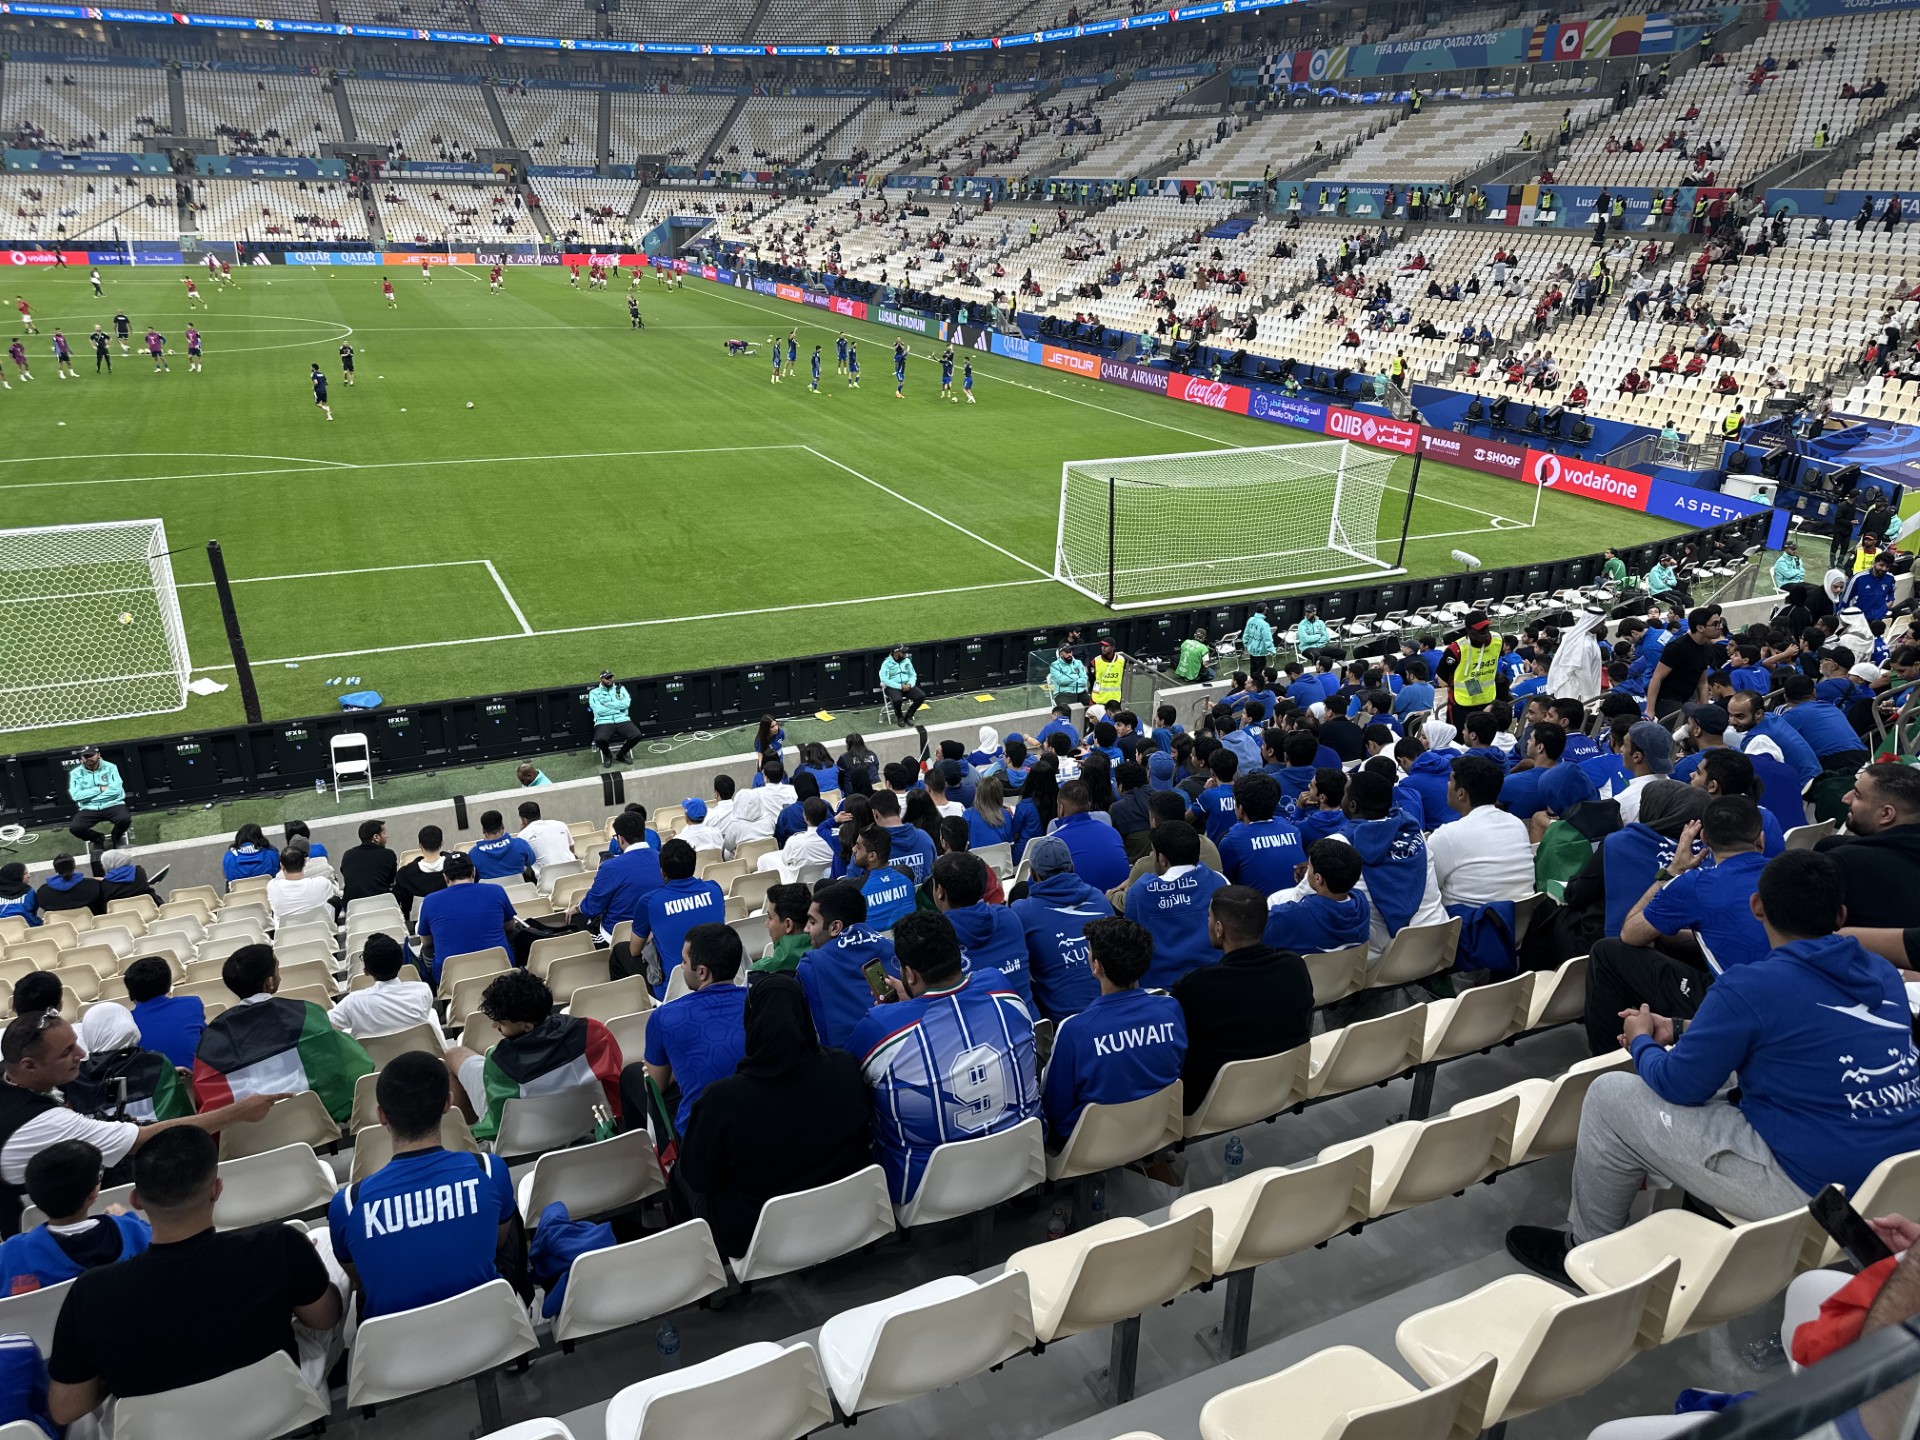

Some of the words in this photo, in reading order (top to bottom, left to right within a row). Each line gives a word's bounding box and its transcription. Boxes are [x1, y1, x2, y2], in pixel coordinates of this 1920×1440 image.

[1374, 45, 1392, 55] FIFA
[1394, 42, 1420, 53] ARAB
[1422, 39, 1441, 50] CUP
[1443, 36, 1472, 51] QATAR
[1473, 33, 1498, 46] 2025
[28, 254, 68, 262] vodafoe
[295, 252, 330, 262] QATAR
[341, 252, 376, 262] QATAR
[780, 289, 800, 299] JETOUR
[878, 311, 898, 326] LUSAIL
[898, 314, 925, 332] STADIUM
[1003, 336, 1029, 354] QATAR
[1048, 352, 1094, 372] JETOUR
[1101, 362, 1128, 380] QATAR
[1131, 370, 1168, 390] AIRWAYS
[1270, 399, 1281, 407] قطر
[1303, 404, 1321, 416] المدينة
[1268, 408, 1283, 418] Media
[1283, 412, 1294, 422] City
[1294, 415, 1309, 424] Qatar
[1330, 412, 1362, 436] QIIB
[1432, 438, 1460, 450] ALKASS
[1486, 451, 1521, 466] SHOOF
[1564, 468, 1637, 498] vodafone
[1674, 496, 1749, 520] ASPETA
[1250, 833, 1297, 850] KUWAIT
[1147, 882, 1175, 892] معاك
[1177, 877, 1198, 890] كلنا
[664, 892, 713, 916] KUWAIT
[867, 885, 907, 907] KUWAIT
[1094, 1022, 1174, 1056] KUWAIT
[949, 1042, 1008, 1134] 9
[363, 1178, 480, 1239] KUWAIT
